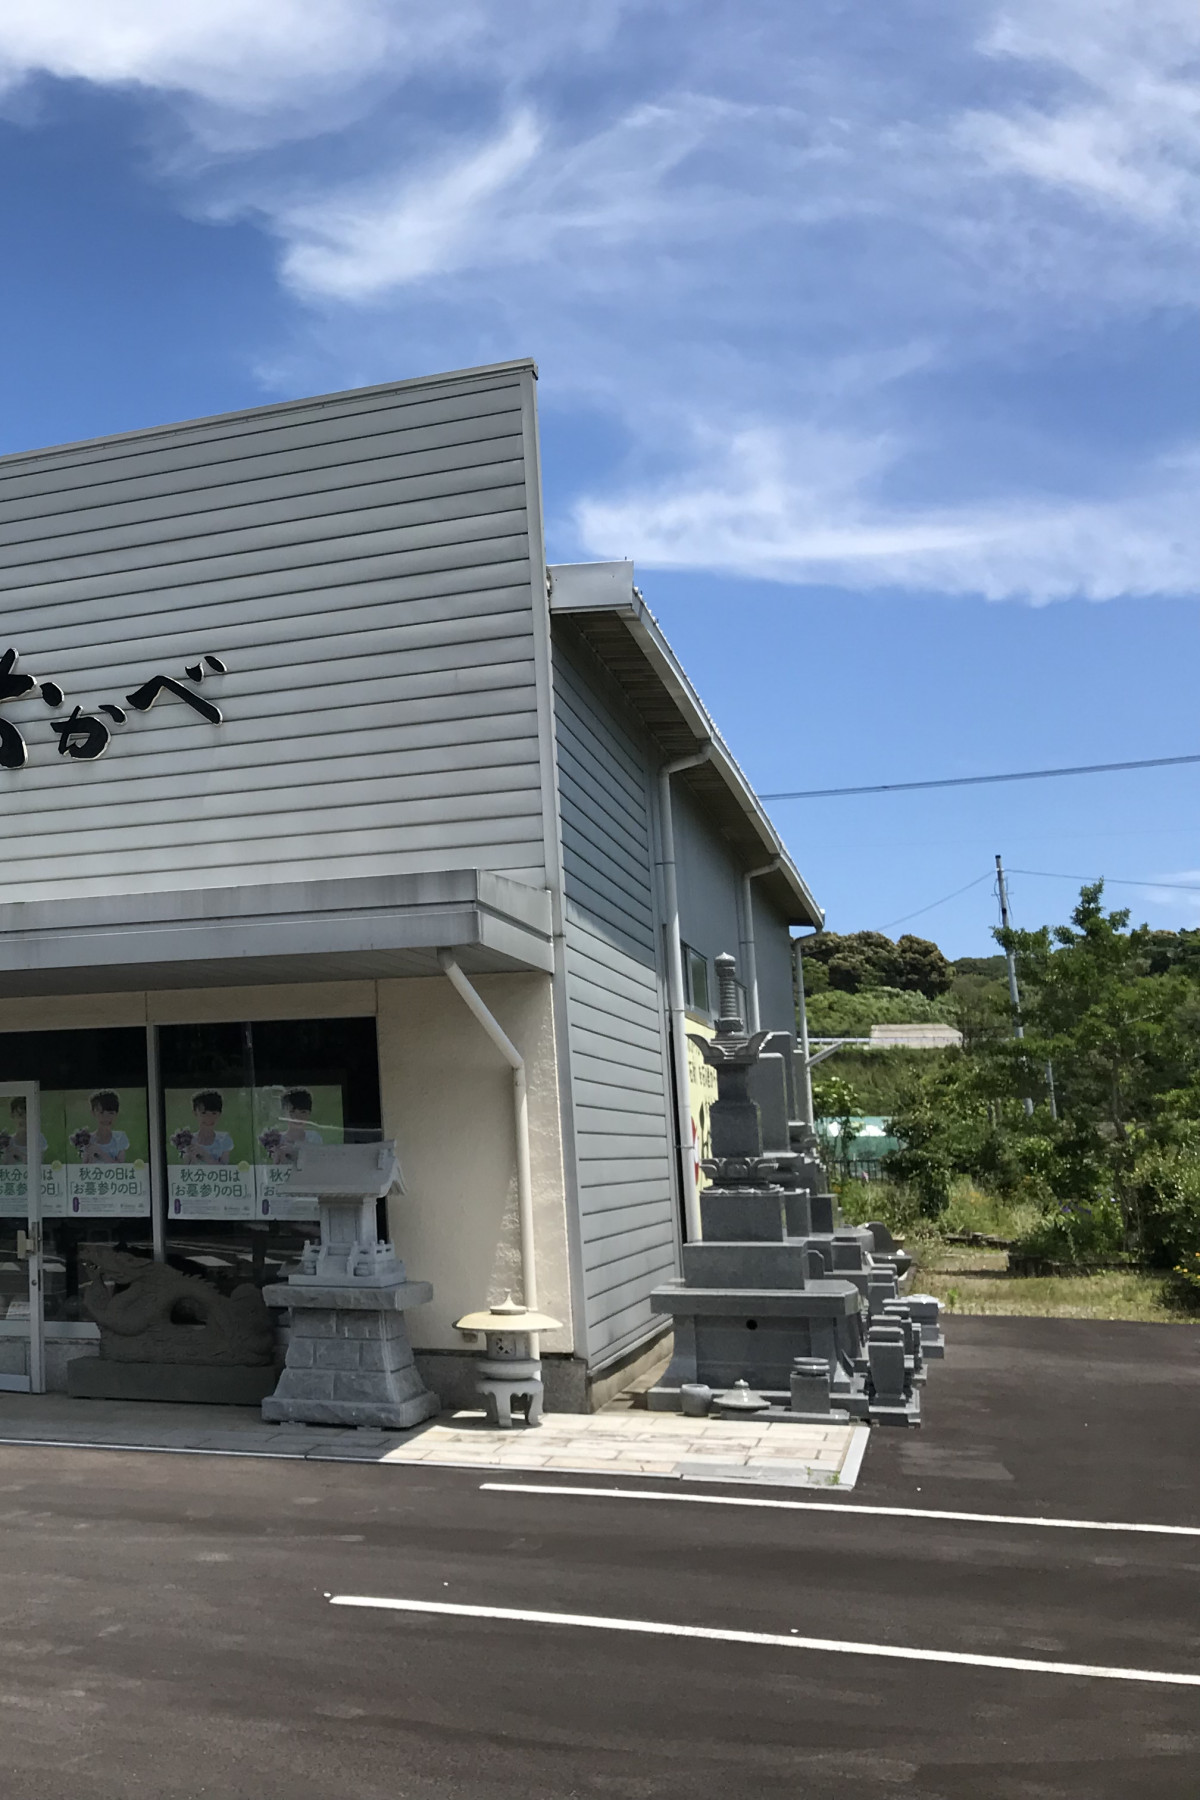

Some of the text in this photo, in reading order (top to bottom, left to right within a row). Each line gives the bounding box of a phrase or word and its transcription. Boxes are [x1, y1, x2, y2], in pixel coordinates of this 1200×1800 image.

[79, 1167, 136, 1181] 秋分の日は
[180, 1168, 240, 1182] 秋分の日は
